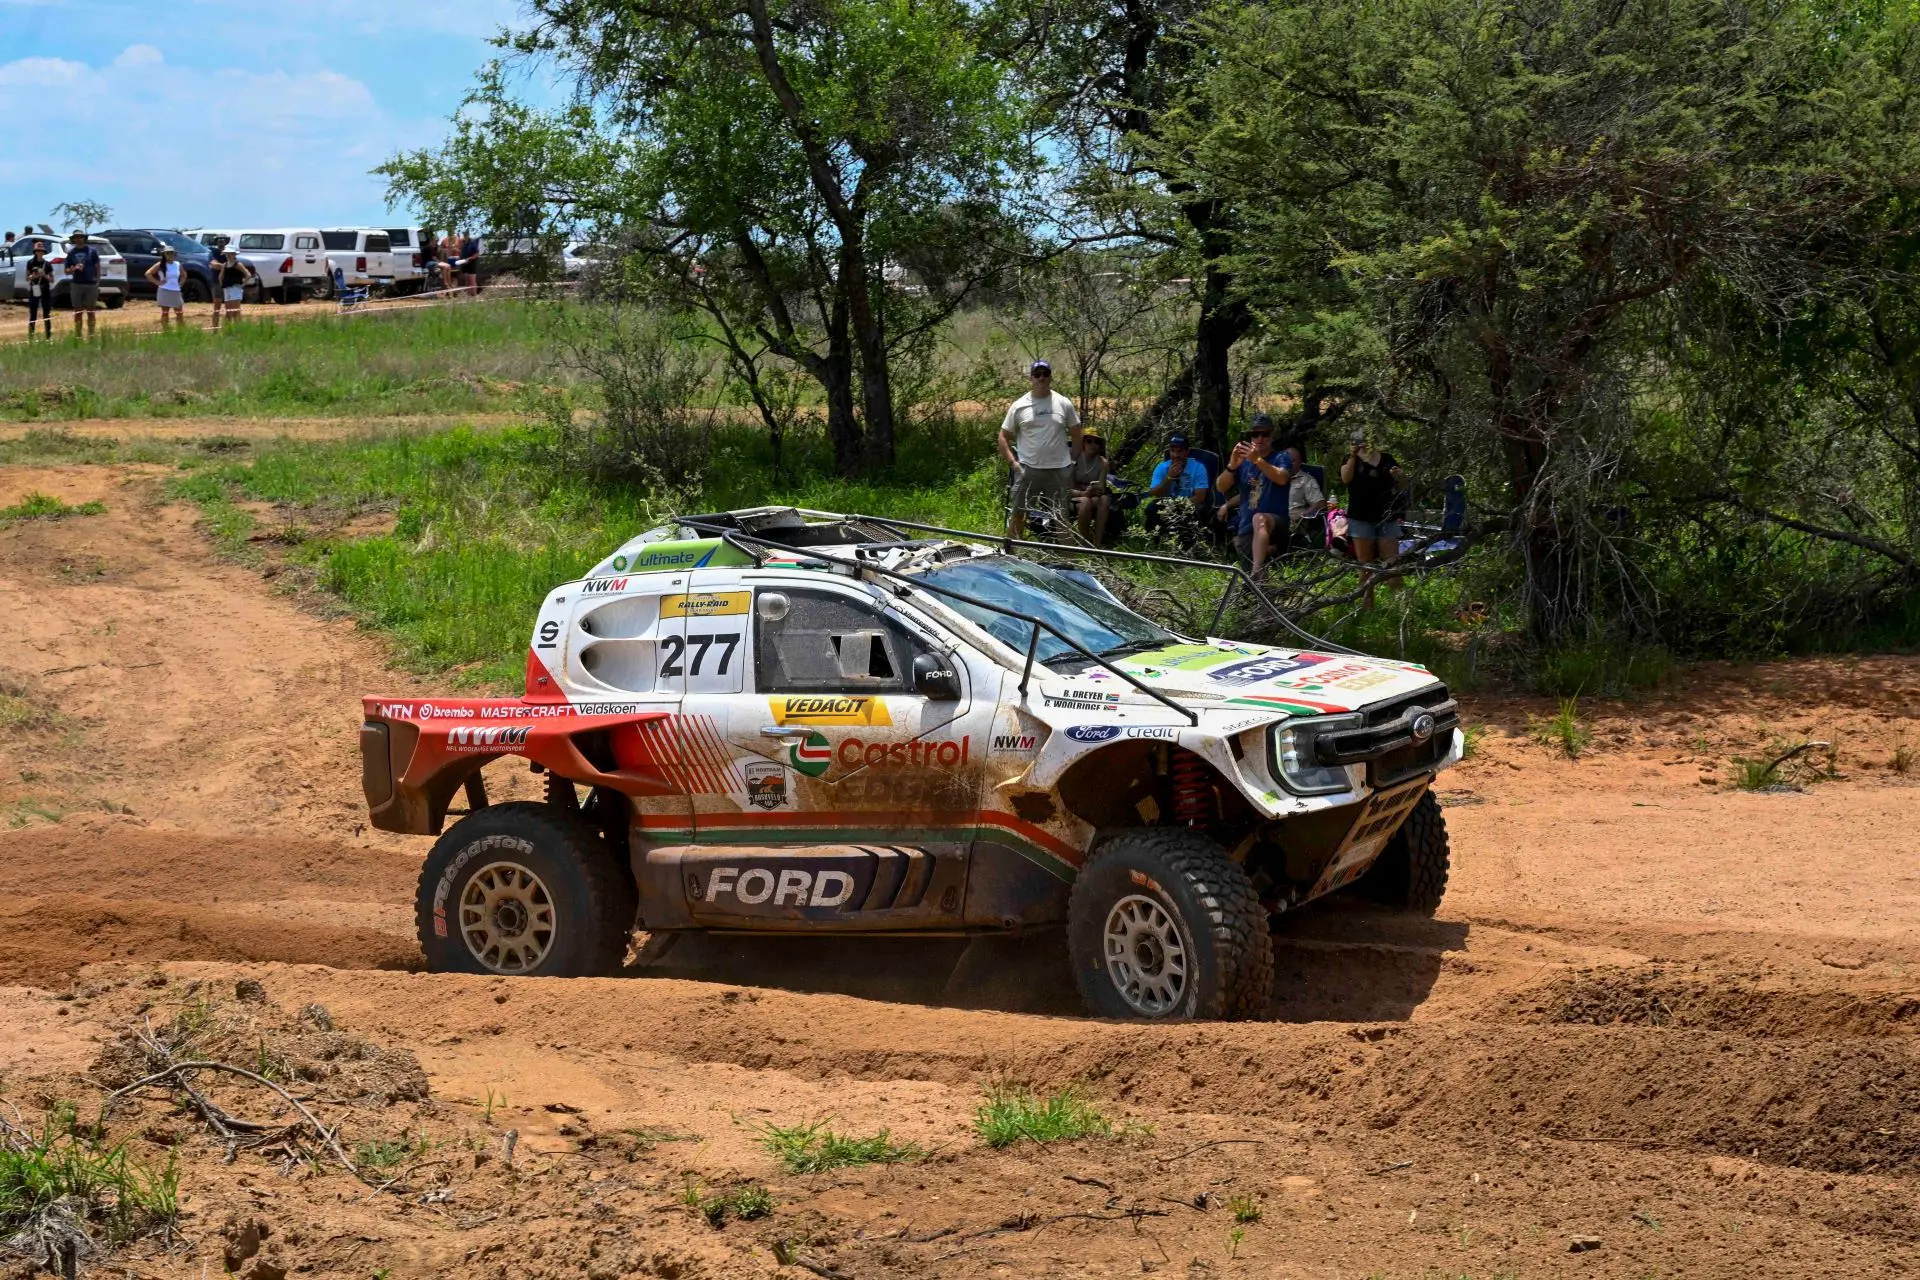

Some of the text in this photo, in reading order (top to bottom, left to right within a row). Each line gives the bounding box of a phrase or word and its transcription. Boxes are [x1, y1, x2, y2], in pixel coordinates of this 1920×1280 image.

[640, 552, 695, 567] ultimate
[582, 578, 629, 593] NWM
[678, 600, 729, 609] RALLY-RAID
[660, 633, 741, 677] 277
[925, 670, 953, 681] FORD
[1227, 659, 1300, 679] FORD
[1063, 689, 1104, 701] B. DREYER
[381, 702, 637, 719] NTN brembo MASTERCRAFT Veldskoen
[785, 698, 869, 713] VEDACIT
[447, 726, 535, 745] NWM
[1127, 726, 1174, 738] Credit
[993, 736, 1036, 749] NWM
[837, 735, 970, 770] Castrol
[705, 867, 855, 907] FORD
